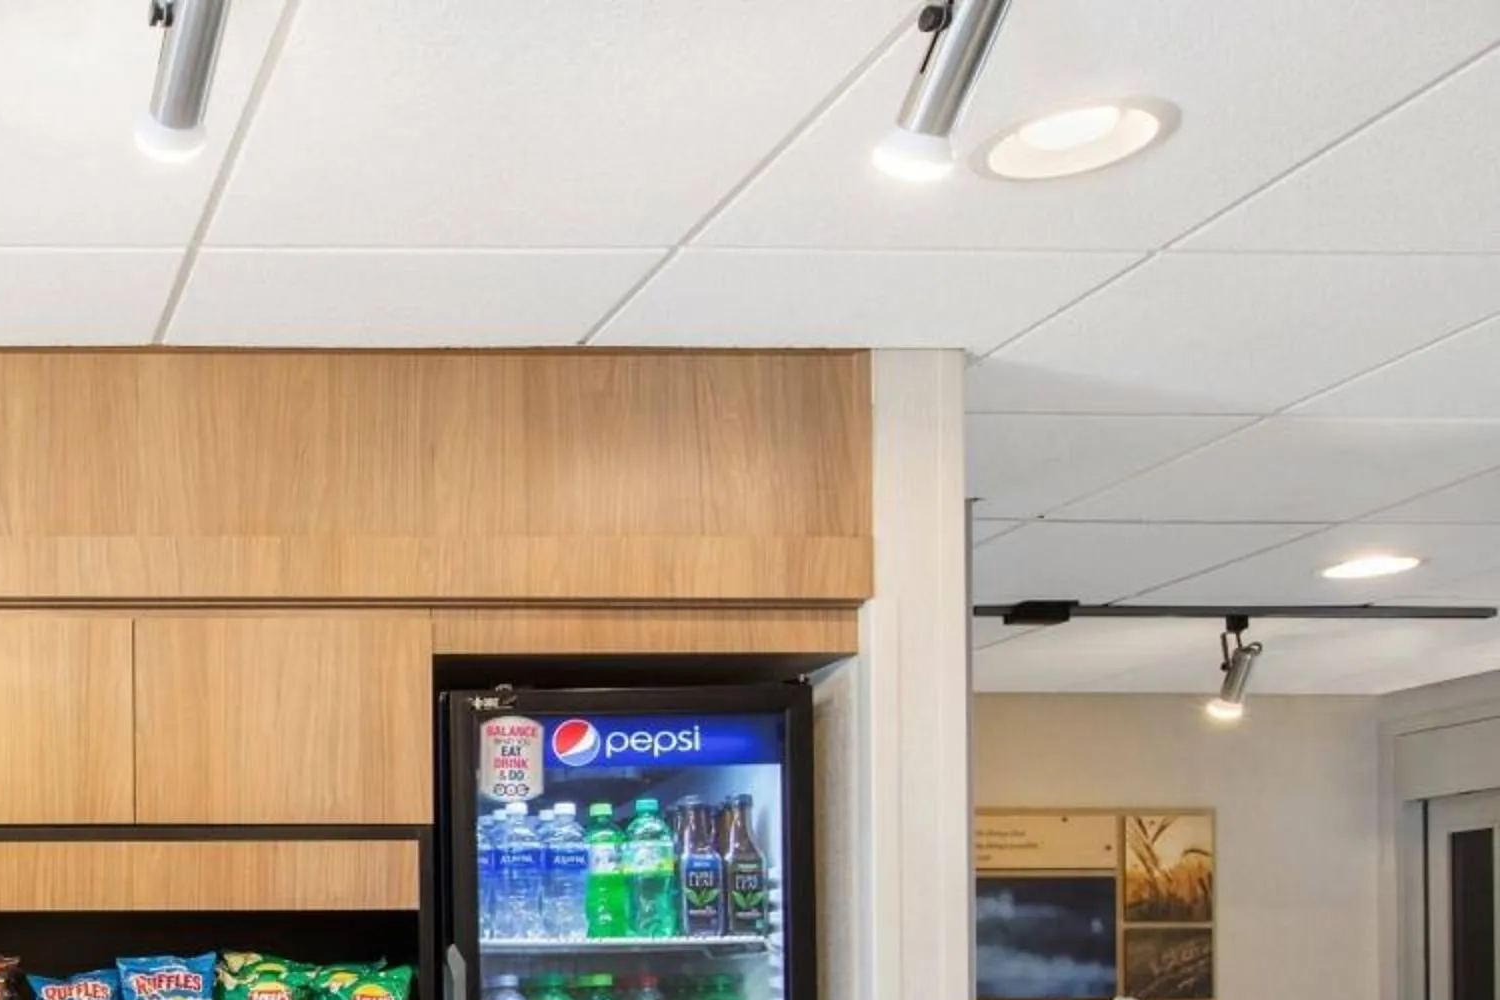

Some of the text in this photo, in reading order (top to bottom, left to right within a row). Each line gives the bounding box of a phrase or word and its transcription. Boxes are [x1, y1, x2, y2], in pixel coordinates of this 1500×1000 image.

[487, 725, 538, 736] BALANCE
[605, 725, 701, 758] pepsi
[501, 746, 522, 756] EAT
[494, 758, 528, 769] DRINK
[134, 970, 202, 993] RUFFLES
